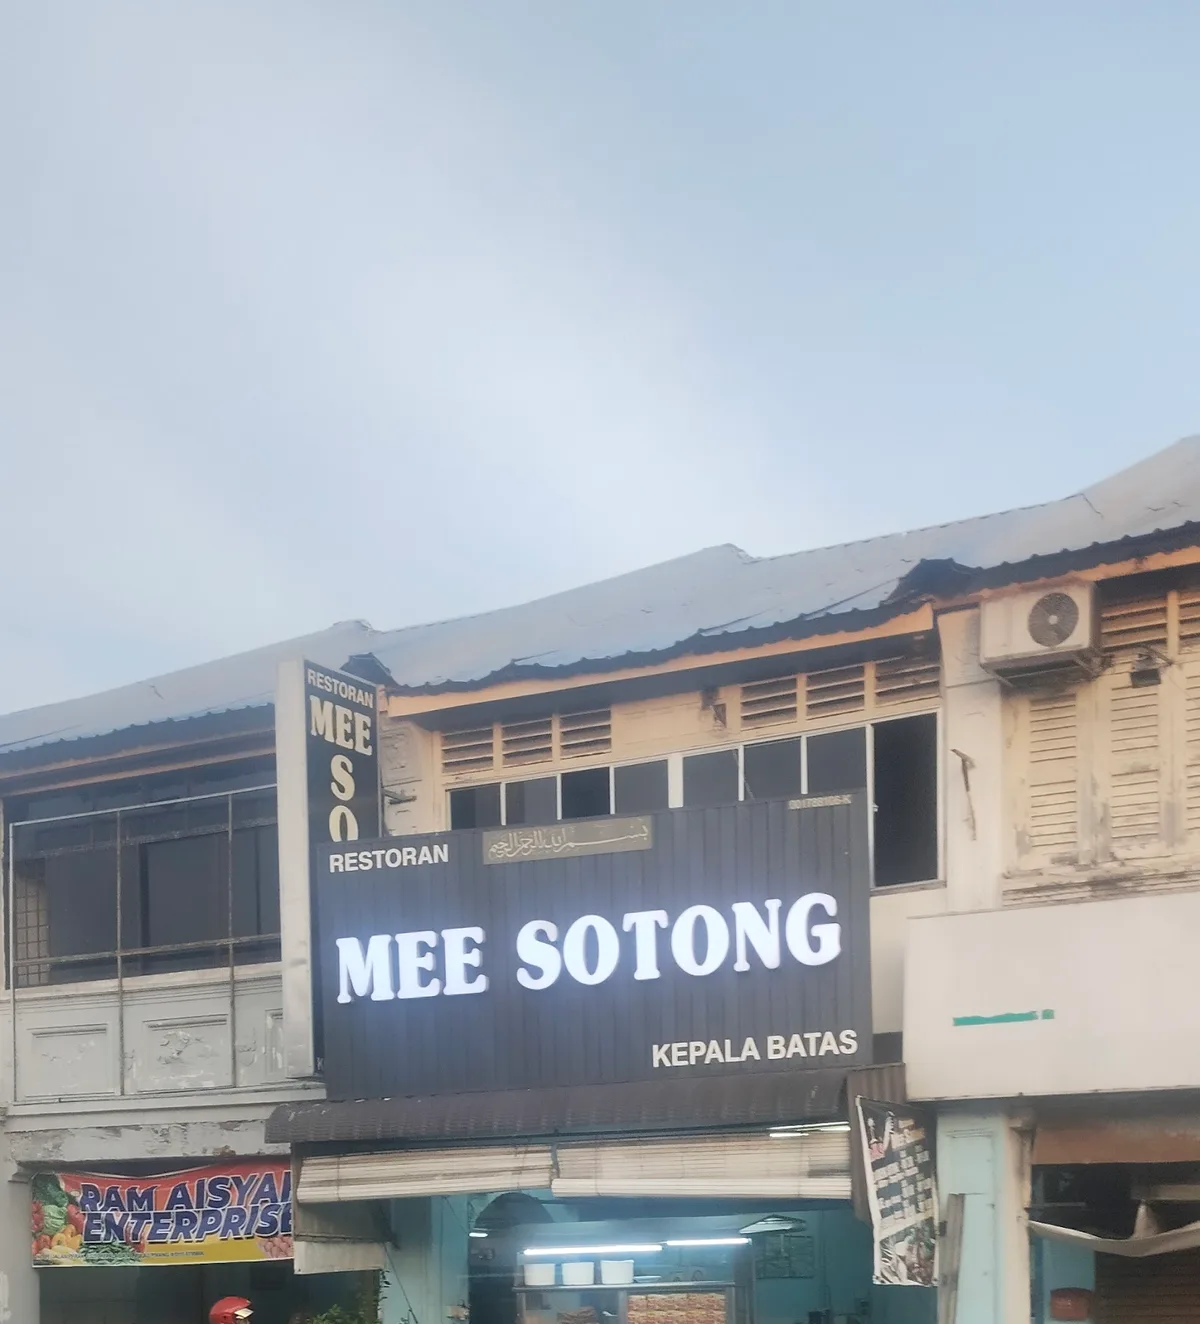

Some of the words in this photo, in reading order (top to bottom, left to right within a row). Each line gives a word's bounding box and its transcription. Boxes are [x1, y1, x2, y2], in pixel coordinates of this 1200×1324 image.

[307, 668, 373, 709] RESTORAN
[309, 694, 373, 756] MEE
[328, 843, 449, 873] RESTORAN
[336, 926, 490, 1004] MEE
[516, 892, 842, 990] SOTONG
[652, 1036, 761, 1068] KEPALA
[766, 1029, 859, 1060] BATAS
[80, 1181, 159, 1213] RAM
